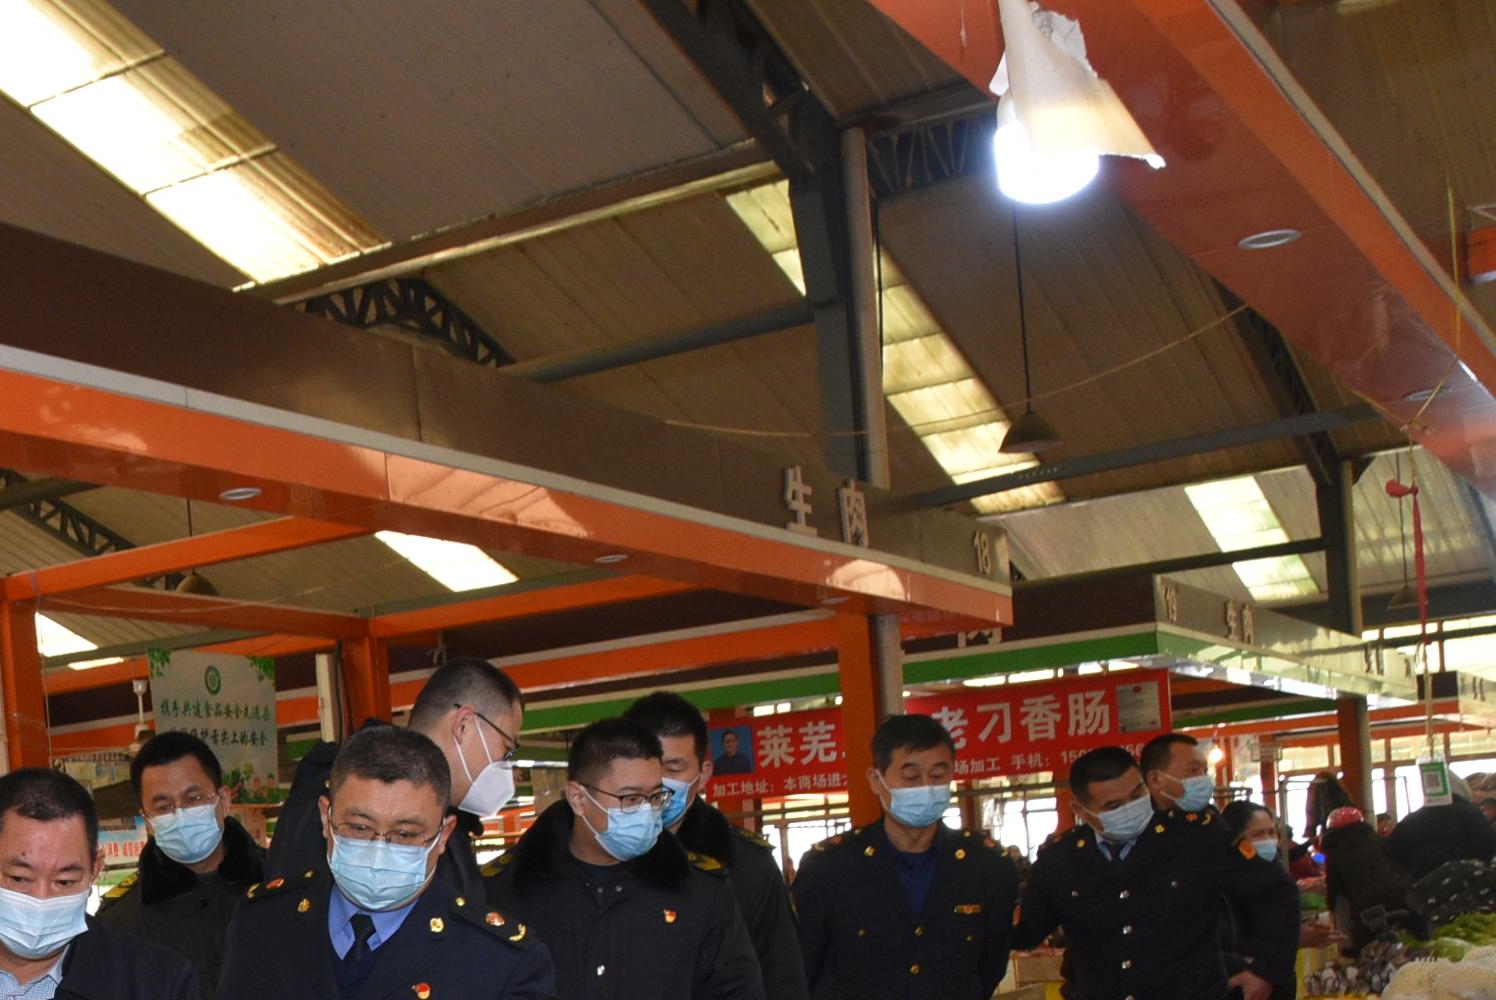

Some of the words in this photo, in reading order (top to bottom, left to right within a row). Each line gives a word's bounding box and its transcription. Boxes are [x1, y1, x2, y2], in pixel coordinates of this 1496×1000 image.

[785, 465, 870, 548] 生肉
[973, 530, 991, 577] 18
[757, 720, 838, 769] 莱芜
